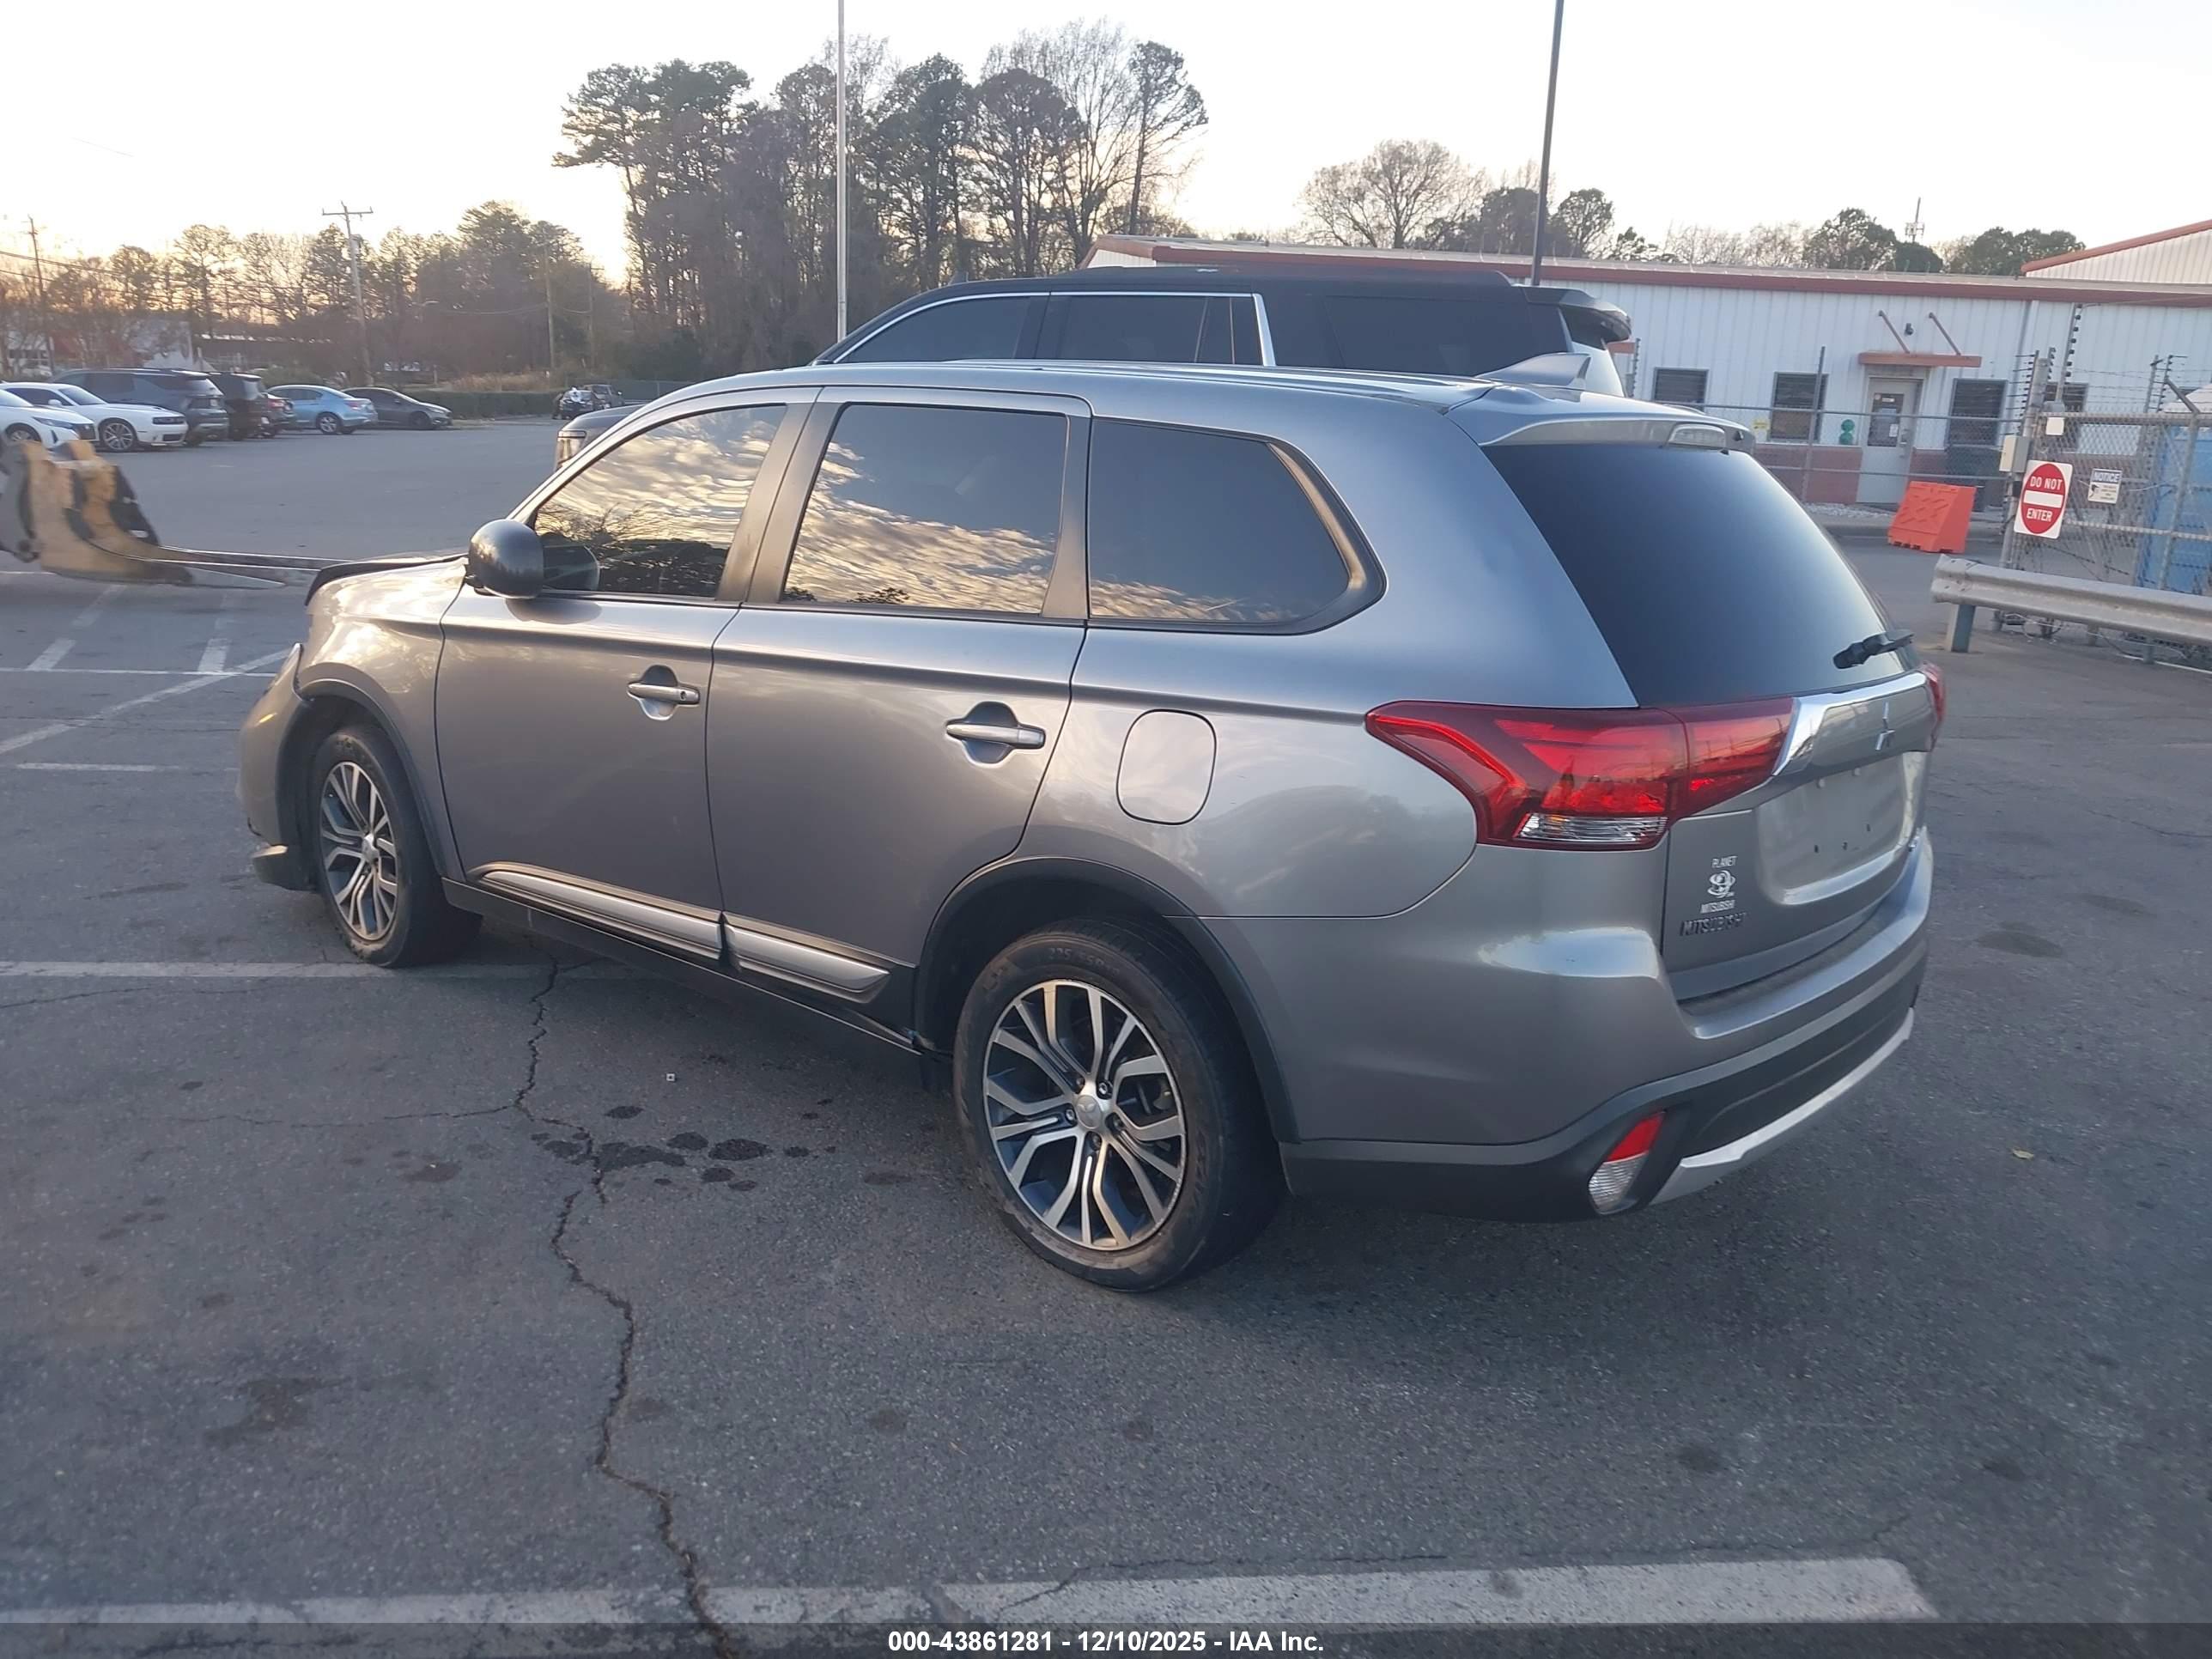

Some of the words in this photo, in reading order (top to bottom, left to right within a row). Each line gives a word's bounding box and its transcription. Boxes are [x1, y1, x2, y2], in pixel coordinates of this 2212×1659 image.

[2030, 476, 2042, 488] DO
[2045, 478, 2063, 490] NOT
[2093, 471, 2120, 483] NOTICE
[2027, 507, 2053, 522] ENTER
[1711, 855, 1738, 868] PLANET
[1680, 912, 1747, 936] MITSUBISHI
